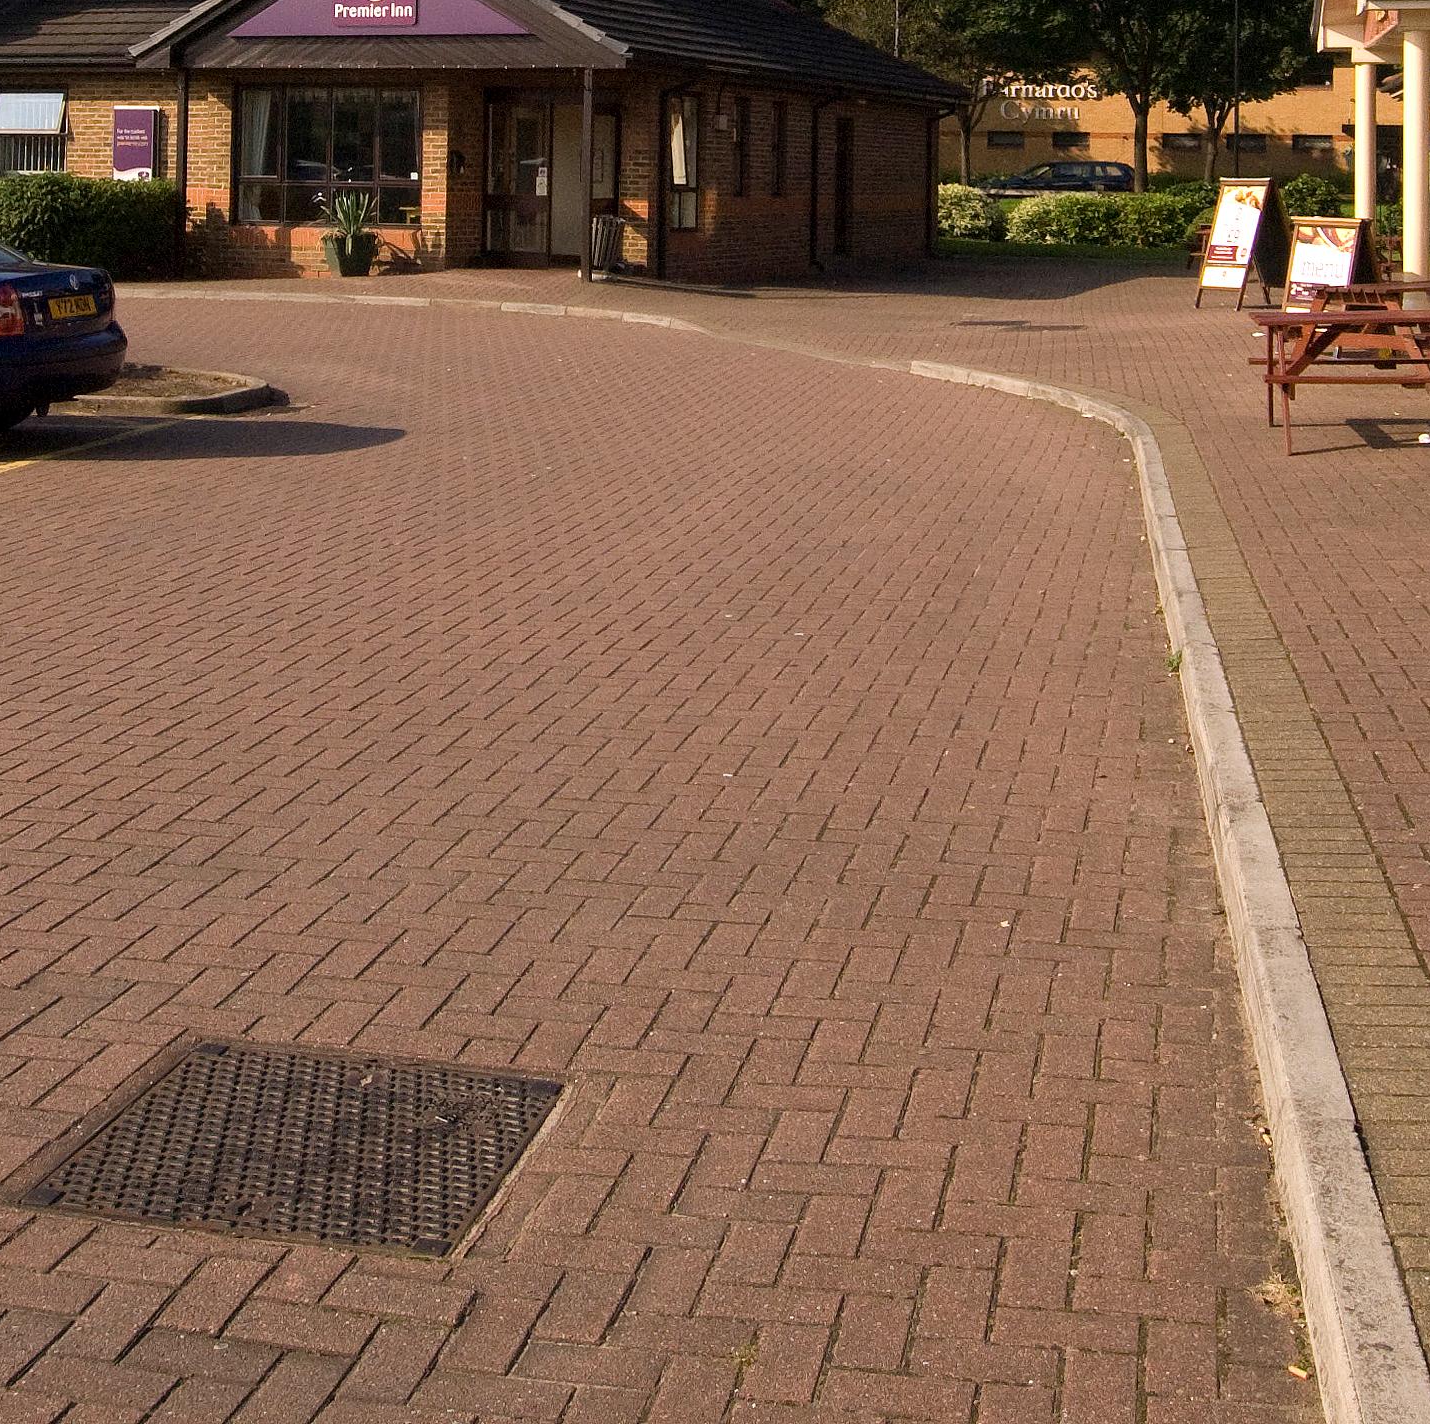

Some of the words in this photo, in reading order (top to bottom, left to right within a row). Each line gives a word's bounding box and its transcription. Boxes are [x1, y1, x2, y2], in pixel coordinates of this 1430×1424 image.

[334, 3, 389, 18] Premier
[391, 2, 413, 18] Inn
[1000, 99, 1080, 124] Cymru
